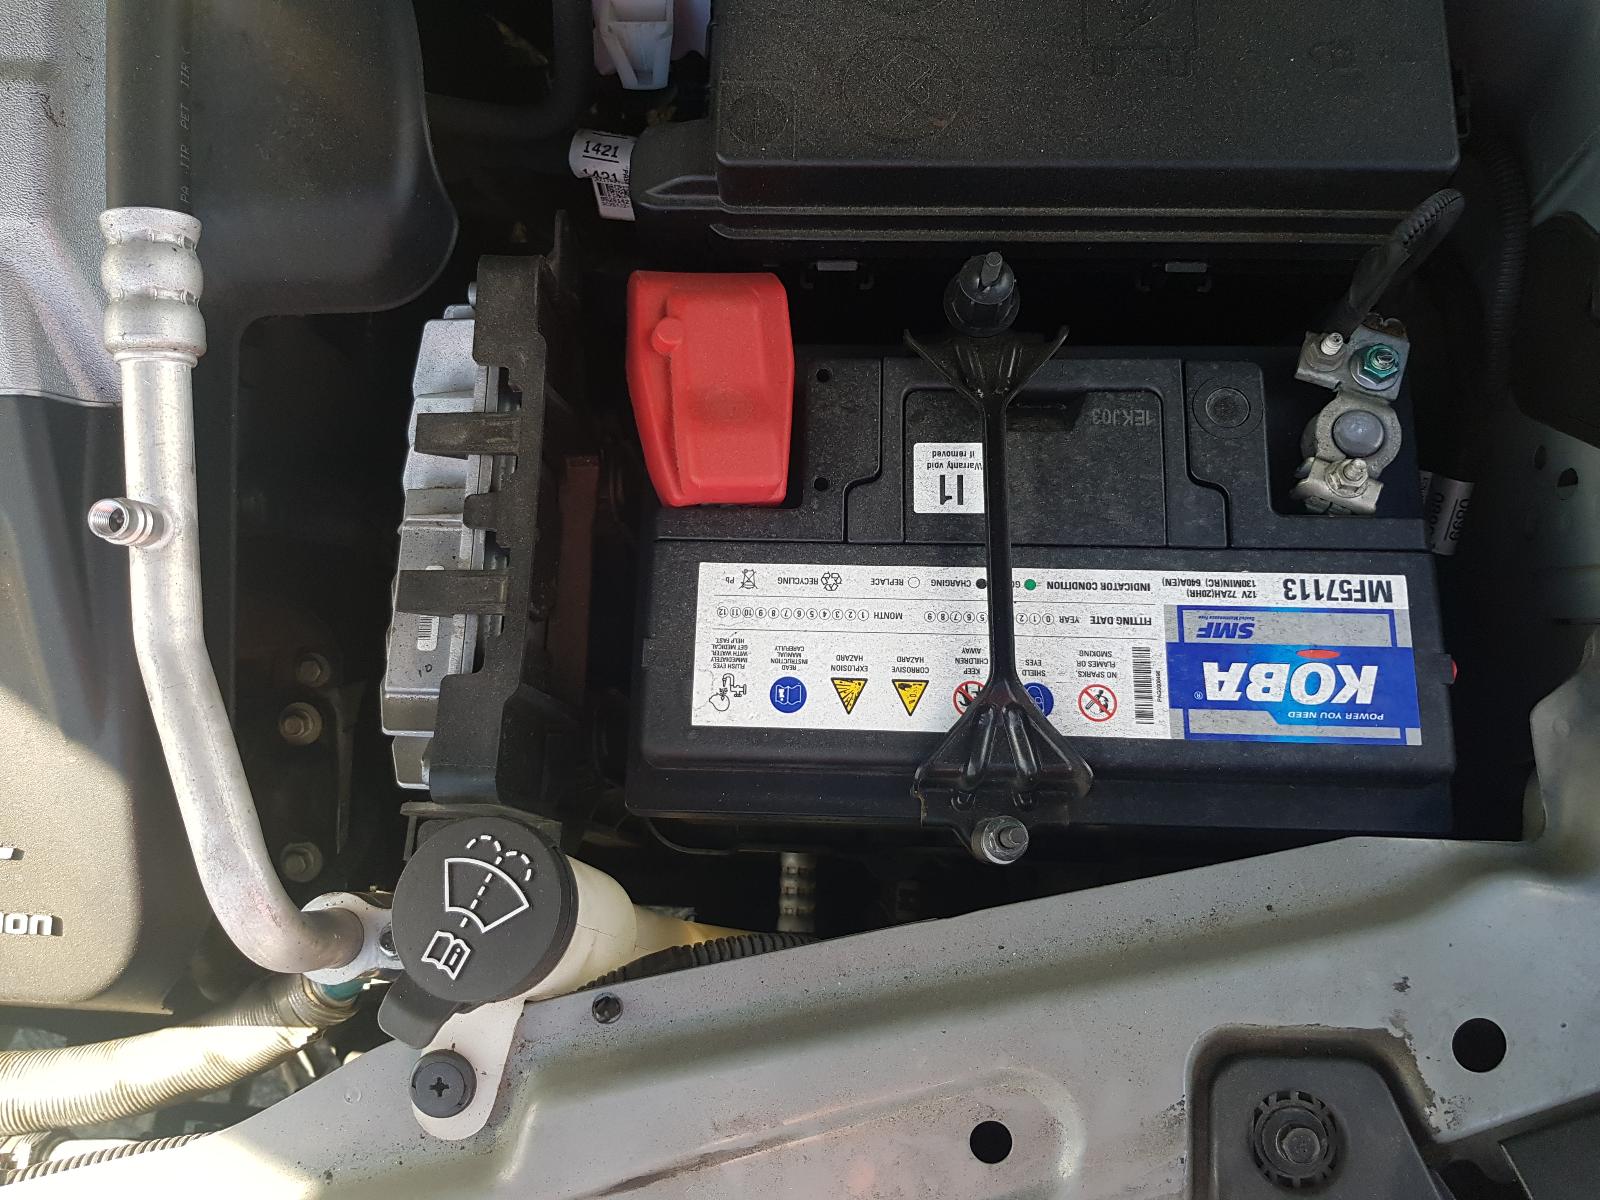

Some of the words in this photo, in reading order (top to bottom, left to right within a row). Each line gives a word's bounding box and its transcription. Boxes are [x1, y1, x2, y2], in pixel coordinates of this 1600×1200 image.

[583, 140, 619, 158] 1421
[947, 461, 982, 470] Warranty
[725, 576, 735, 584] Pb
[777, 576, 819, 585] RECYCLING
[870, 578, 904, 586] REPLACE
[931, 579, 972, 587] CHARGING
[1161, 578, 1201, 587] 640A(EN)
[1205, 578, 1257, 588] 130MIN(RC)
[1047, 580, 1098, 590] CONDITION
[1100, 581, 1151, 591] INDICATOR
[1186, 588, 1237, 599] 72AH(20HR)
[1241, 590, 1257, 599] 12V
[1282, 578, 1392, 603] MF57113
[873, 611, 903, 619] MONTH
[1059, 615, 1080, 623] YEAR
[1090, 615, 1114, 624] DATE
[1116, 616, 1152, 625] FITTING
[1196, 622, 1255, 639] SMF
[961, 647, 982, 655] AWAY
[1078, 649, 1113, 658] SMOKING
[835, 654, 863, 662] HAZARD
[954, 657, 989, 665] CHILDREN
[830, 664, 868, 672] EXPLOSION
[1076, 660, 1087, 668] OR
[1088, 660, 1116, 668] FLAMES
[963, 667, 981, 675] KEEP
[1022, 669, 1046, 677] SHIELD
[1202, 662, 1378, 705] KOBA
[1287, 711, 1317, 719] NEED
[1320, 711, 1342, 720] YOU
[1345, 712, 1384, 721] POWER
